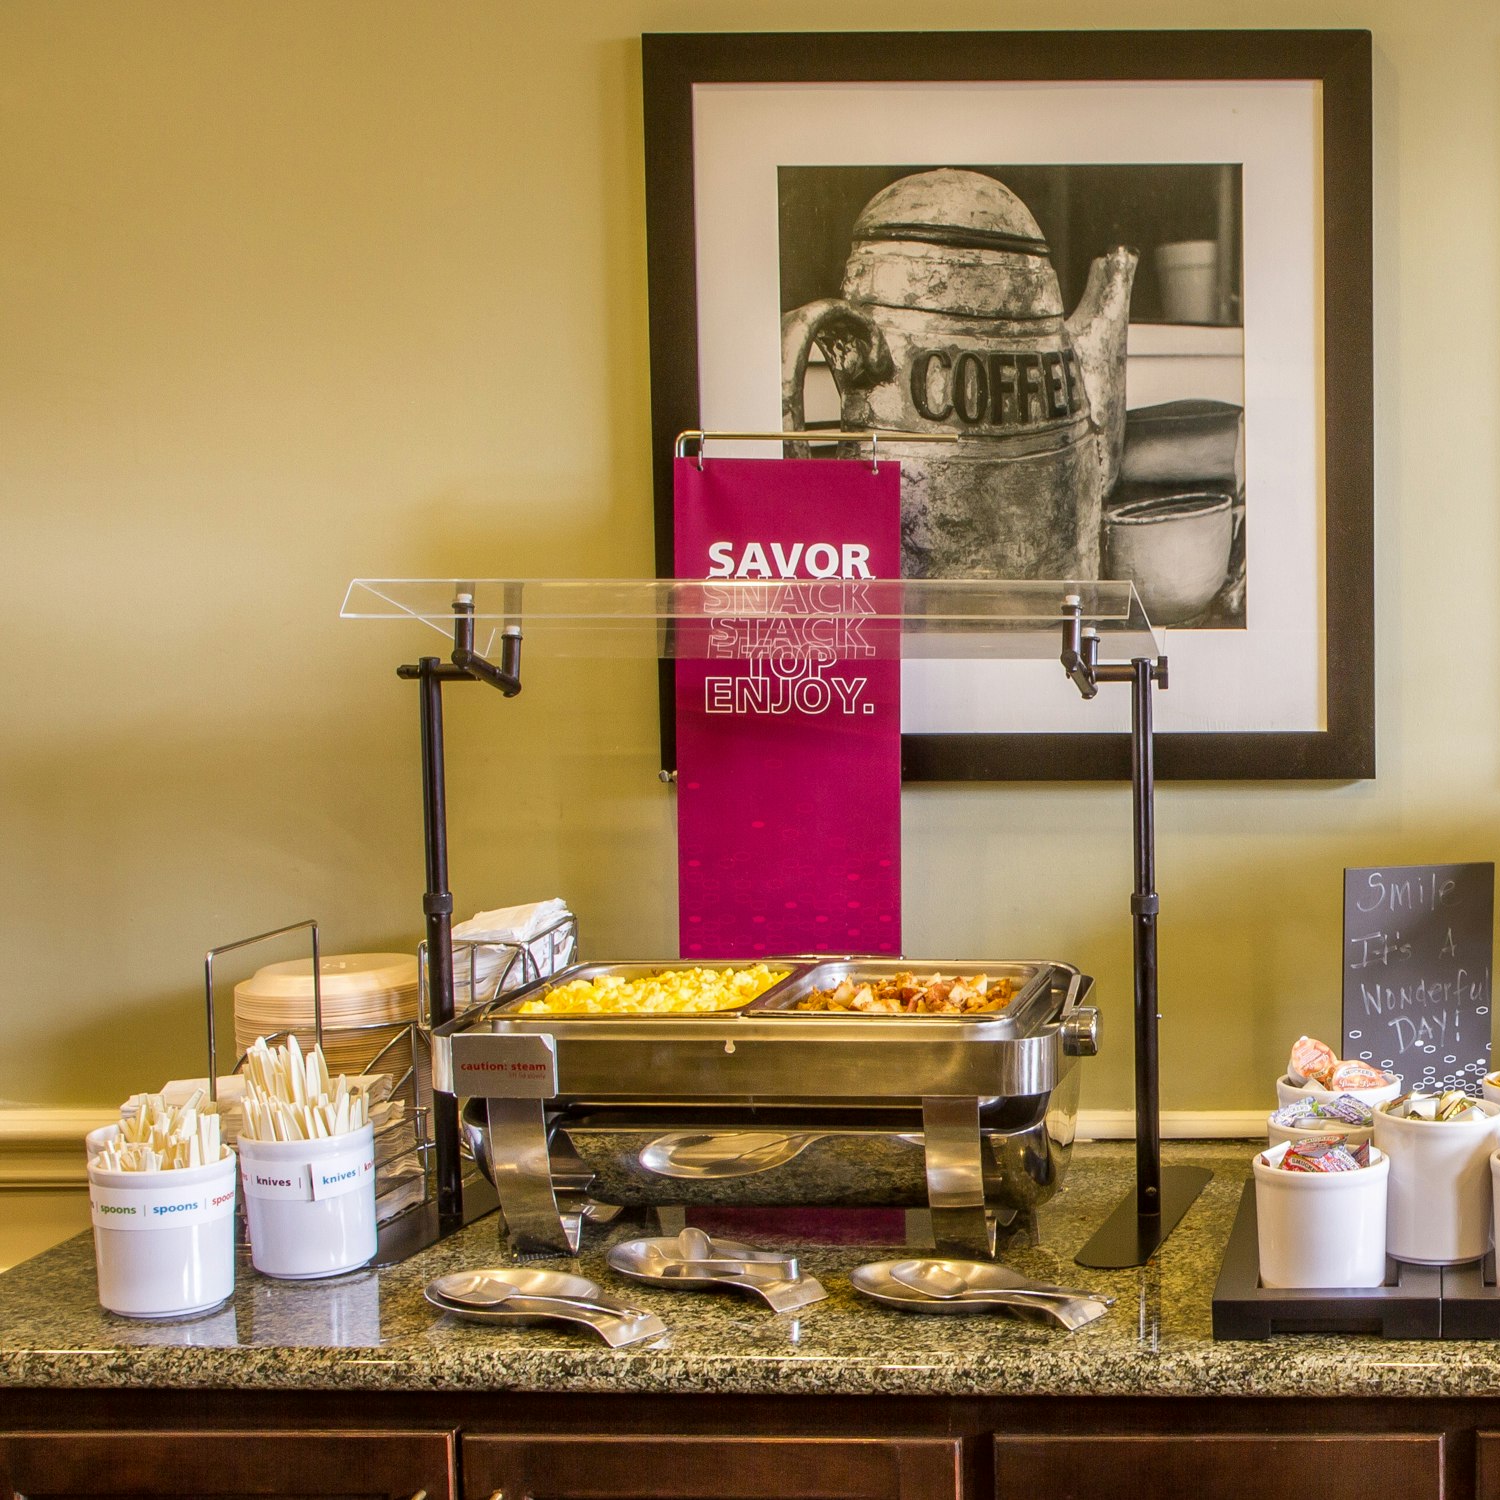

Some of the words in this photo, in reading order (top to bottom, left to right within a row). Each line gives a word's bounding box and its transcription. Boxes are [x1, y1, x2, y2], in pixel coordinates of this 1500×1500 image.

[909, 349, 1080, 425] COFFEE
[708, 541, 871, 579] SAVOR
[703, 575, 877, 615] SNACK
[705, 677, 875, 714] ENJOY.
[1357, 872, 1458, 912] Smile
[1438, 927, 1458, 960] A
[1388, 1008, 1460, 1054] DAY!
[461, 1062, 507, 1071] caution:
[511, 1062, 546, 1071] steam
[256, 1176, 291, 1187] knives
[322, 1169, 357, 1185] knives
[101, 1204, 136, 1214] spoons
[153, 1202, 198, 1215] spoons
